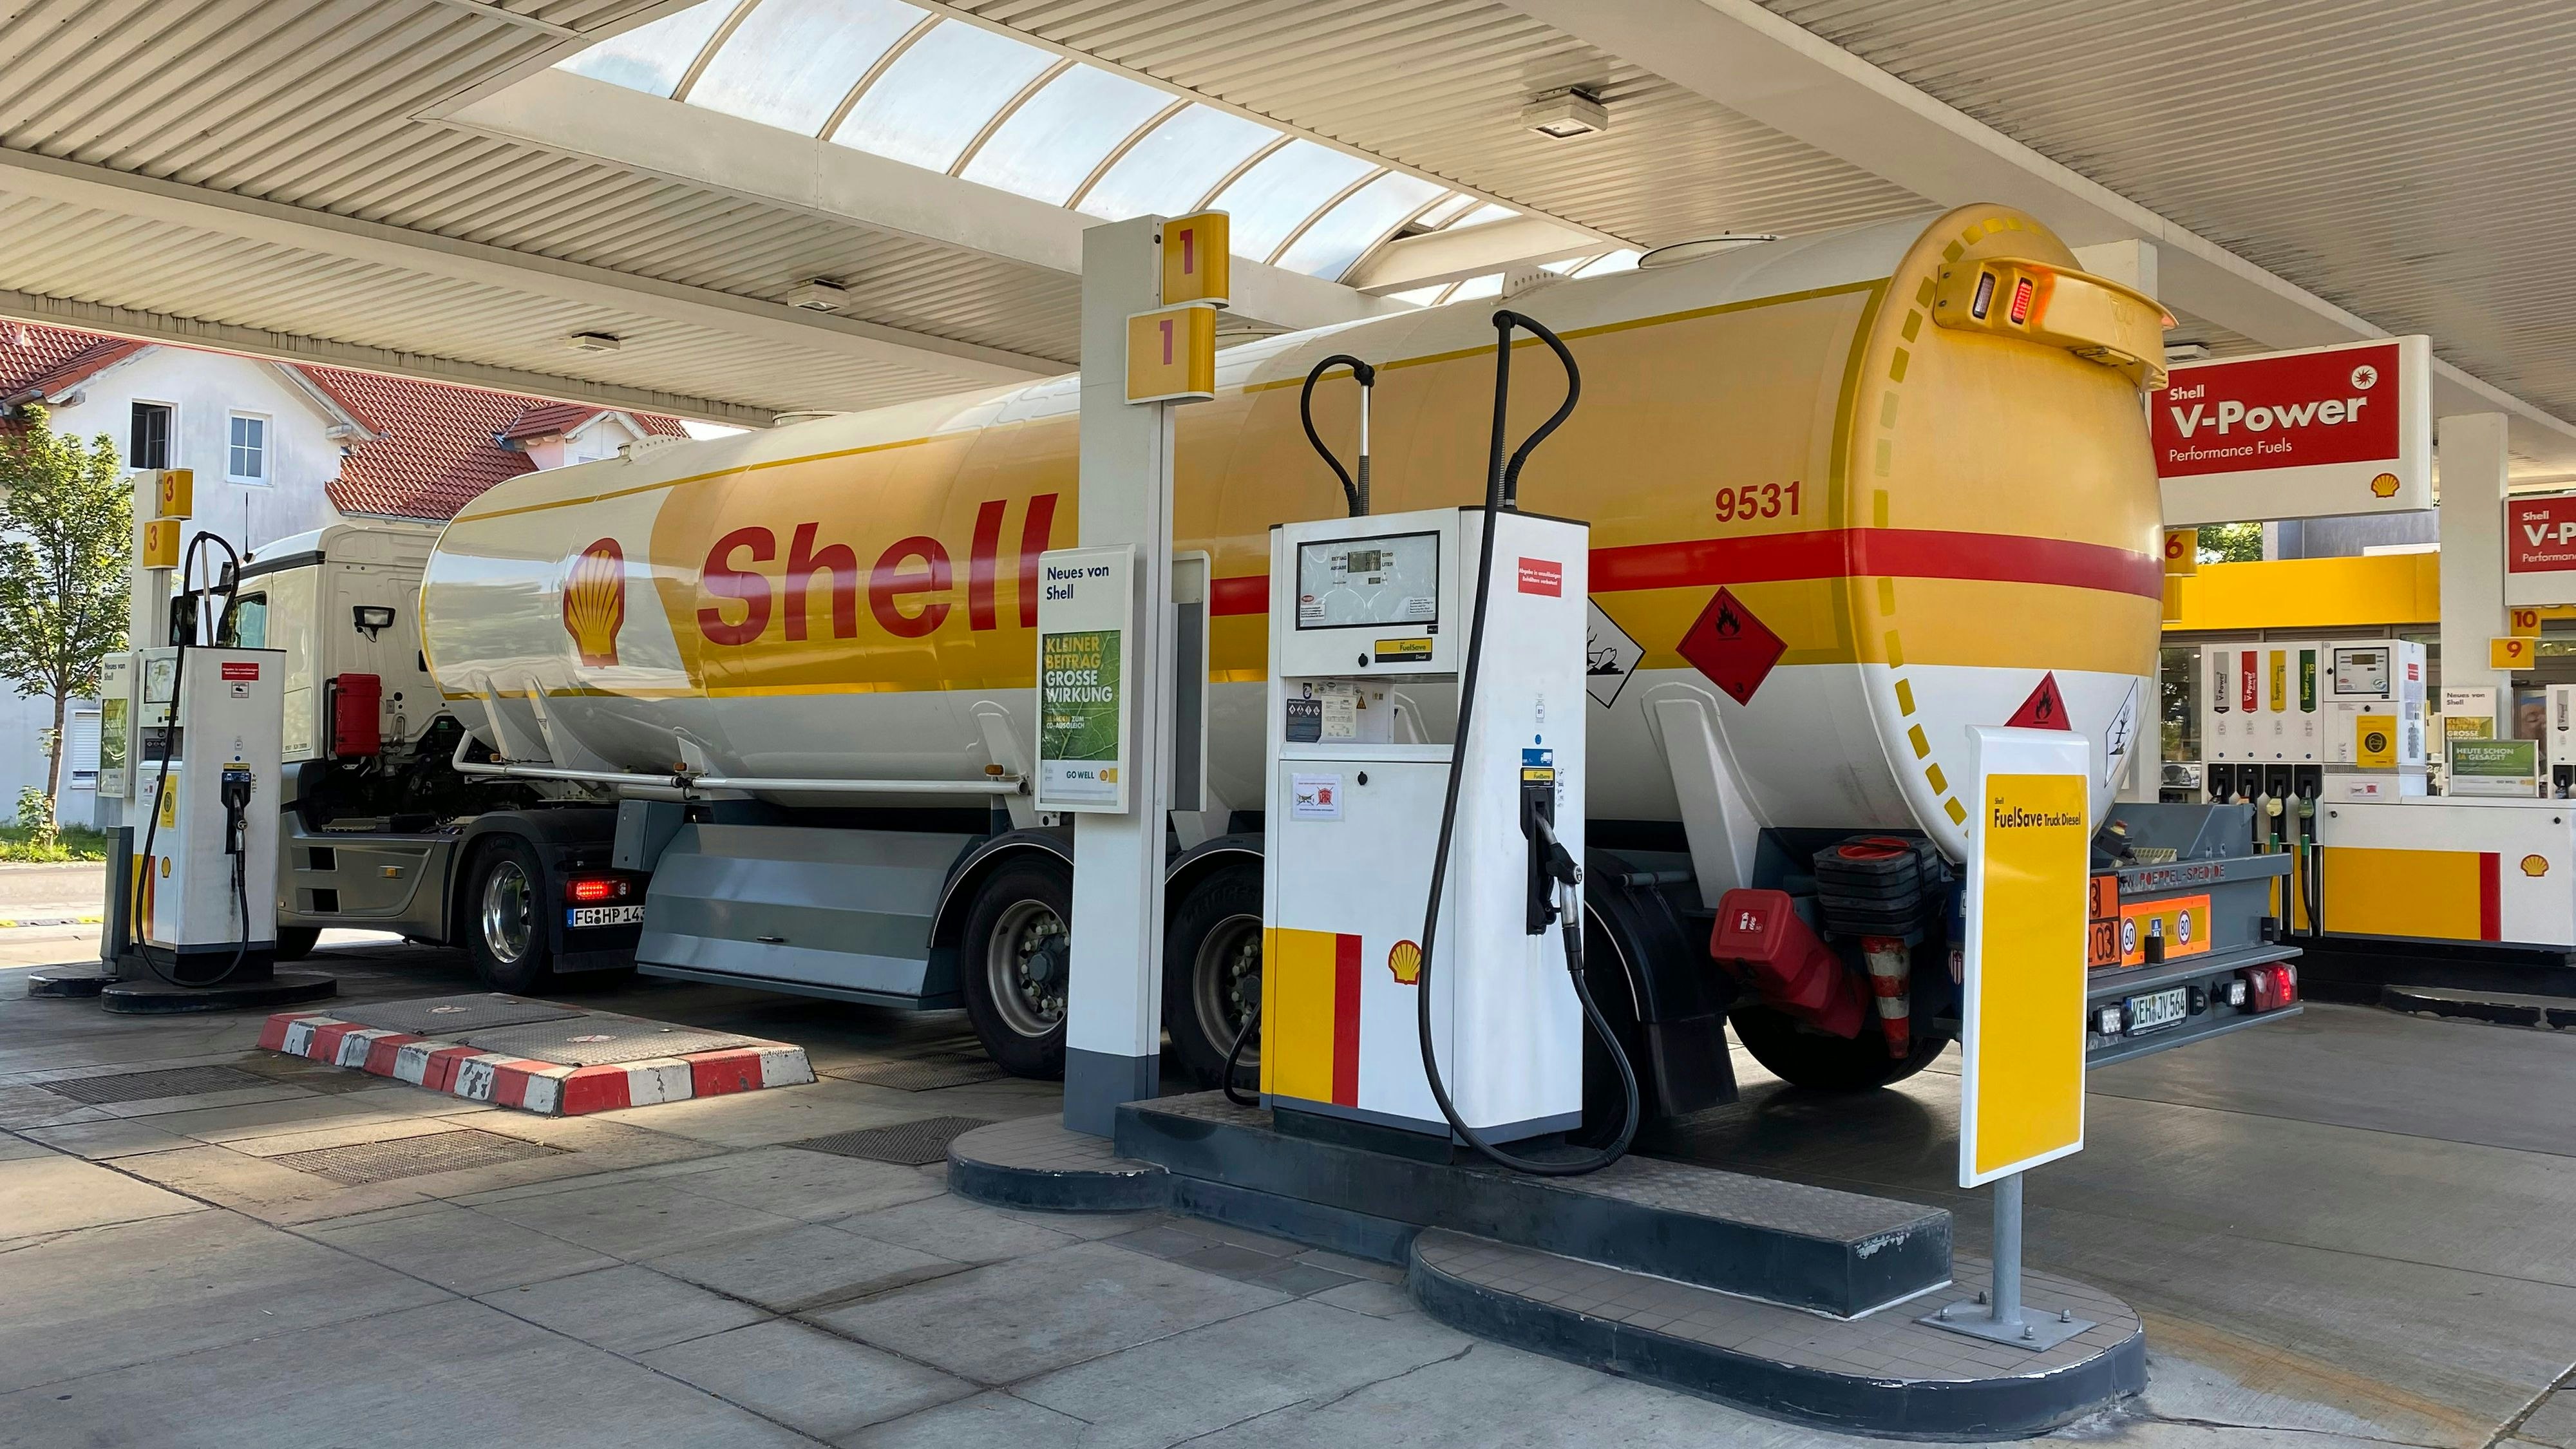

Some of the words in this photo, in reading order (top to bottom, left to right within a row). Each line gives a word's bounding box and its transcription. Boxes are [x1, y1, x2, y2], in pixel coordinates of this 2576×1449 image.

[1180, 229, 1193, 274] 1
[1160, 319, 1173, 365] 1
[2170, 384, 2204, 401] Shell
[2170, 397, 2367, 438] V-Power
[2170, 446, 2253, 462] Performance
[2257, 438, 2292, 454] Fuels
[166, 475, 174, 502] 3
[1716, 481, 1800, 522] 9531
[2523, 511, 2550, 520] Shell
[149, 526, 157, 551] 3
[2523, 522, 2576, 547] V-P
[2165, 534, 2184, 559] 6
[697, 493, 1059, 646] Shell
[1047, 567, 1083, 580] Neues
[1087, 566, 1109, 577] von
[1046, 583, 1074, 600] Shell
[2514, 611, 2538, 628] 10
[1046, 636, 1101, 652] KLEINER
[2506, 641, 2523, 658] 9
[1046, 653, 1101, 670] BEITRAG
[1046, 670, 1098, 687] GROSSE
[1046, 687, 1113, 703] WIRKUNG
[1077, 771, 1095, 779] WELL
[1994, 806, 2042, 828] FuelSave
[2044, 812, 2061, 827] Truck
[2062, 811, 2081, 826] Diesel
[575, 910, 592, 924] FG
[603, 909, 620, 923] HP
[2181, 919, 2188, 936] 80
[2125, 928, 2134, 945] 60
[2133, 1001, 2151, 1026] KEH
[2157, 995, 2168, 1020] JY
[2170, 990, 2185, 1018] 564
